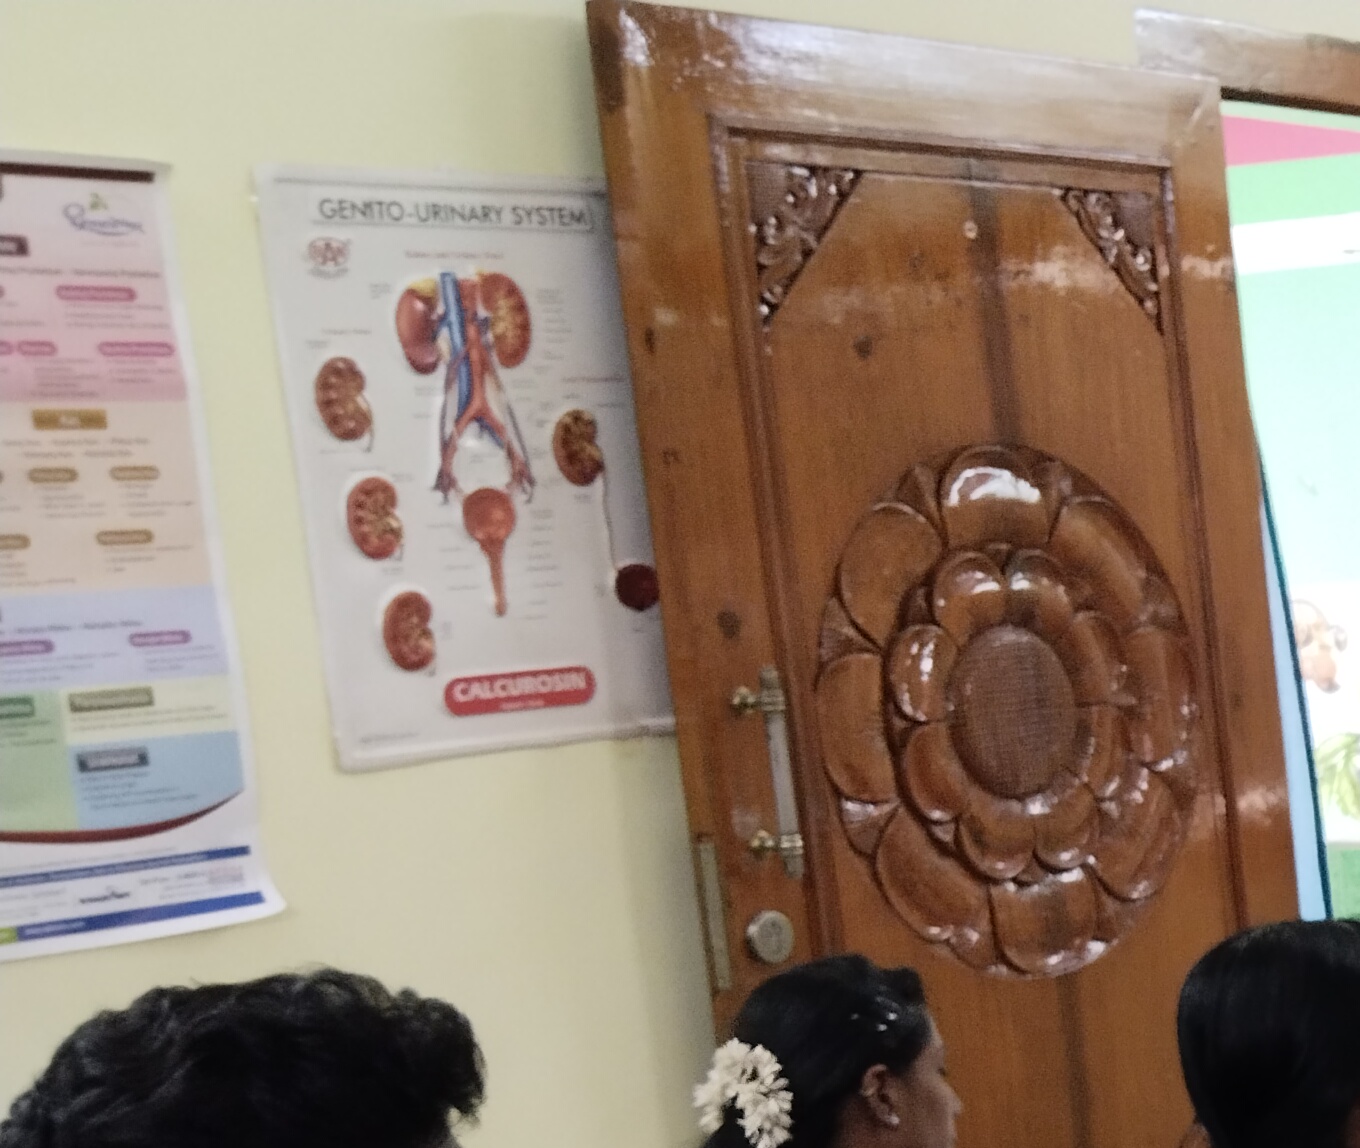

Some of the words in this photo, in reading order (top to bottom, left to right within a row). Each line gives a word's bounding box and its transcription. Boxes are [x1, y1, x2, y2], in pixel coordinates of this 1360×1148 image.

[318, 197, 504, 225] GENITO-URINARY
[511, 205, 588, 228] SYSTEM
[452, 670, 587, 703] CALCUROSIN
